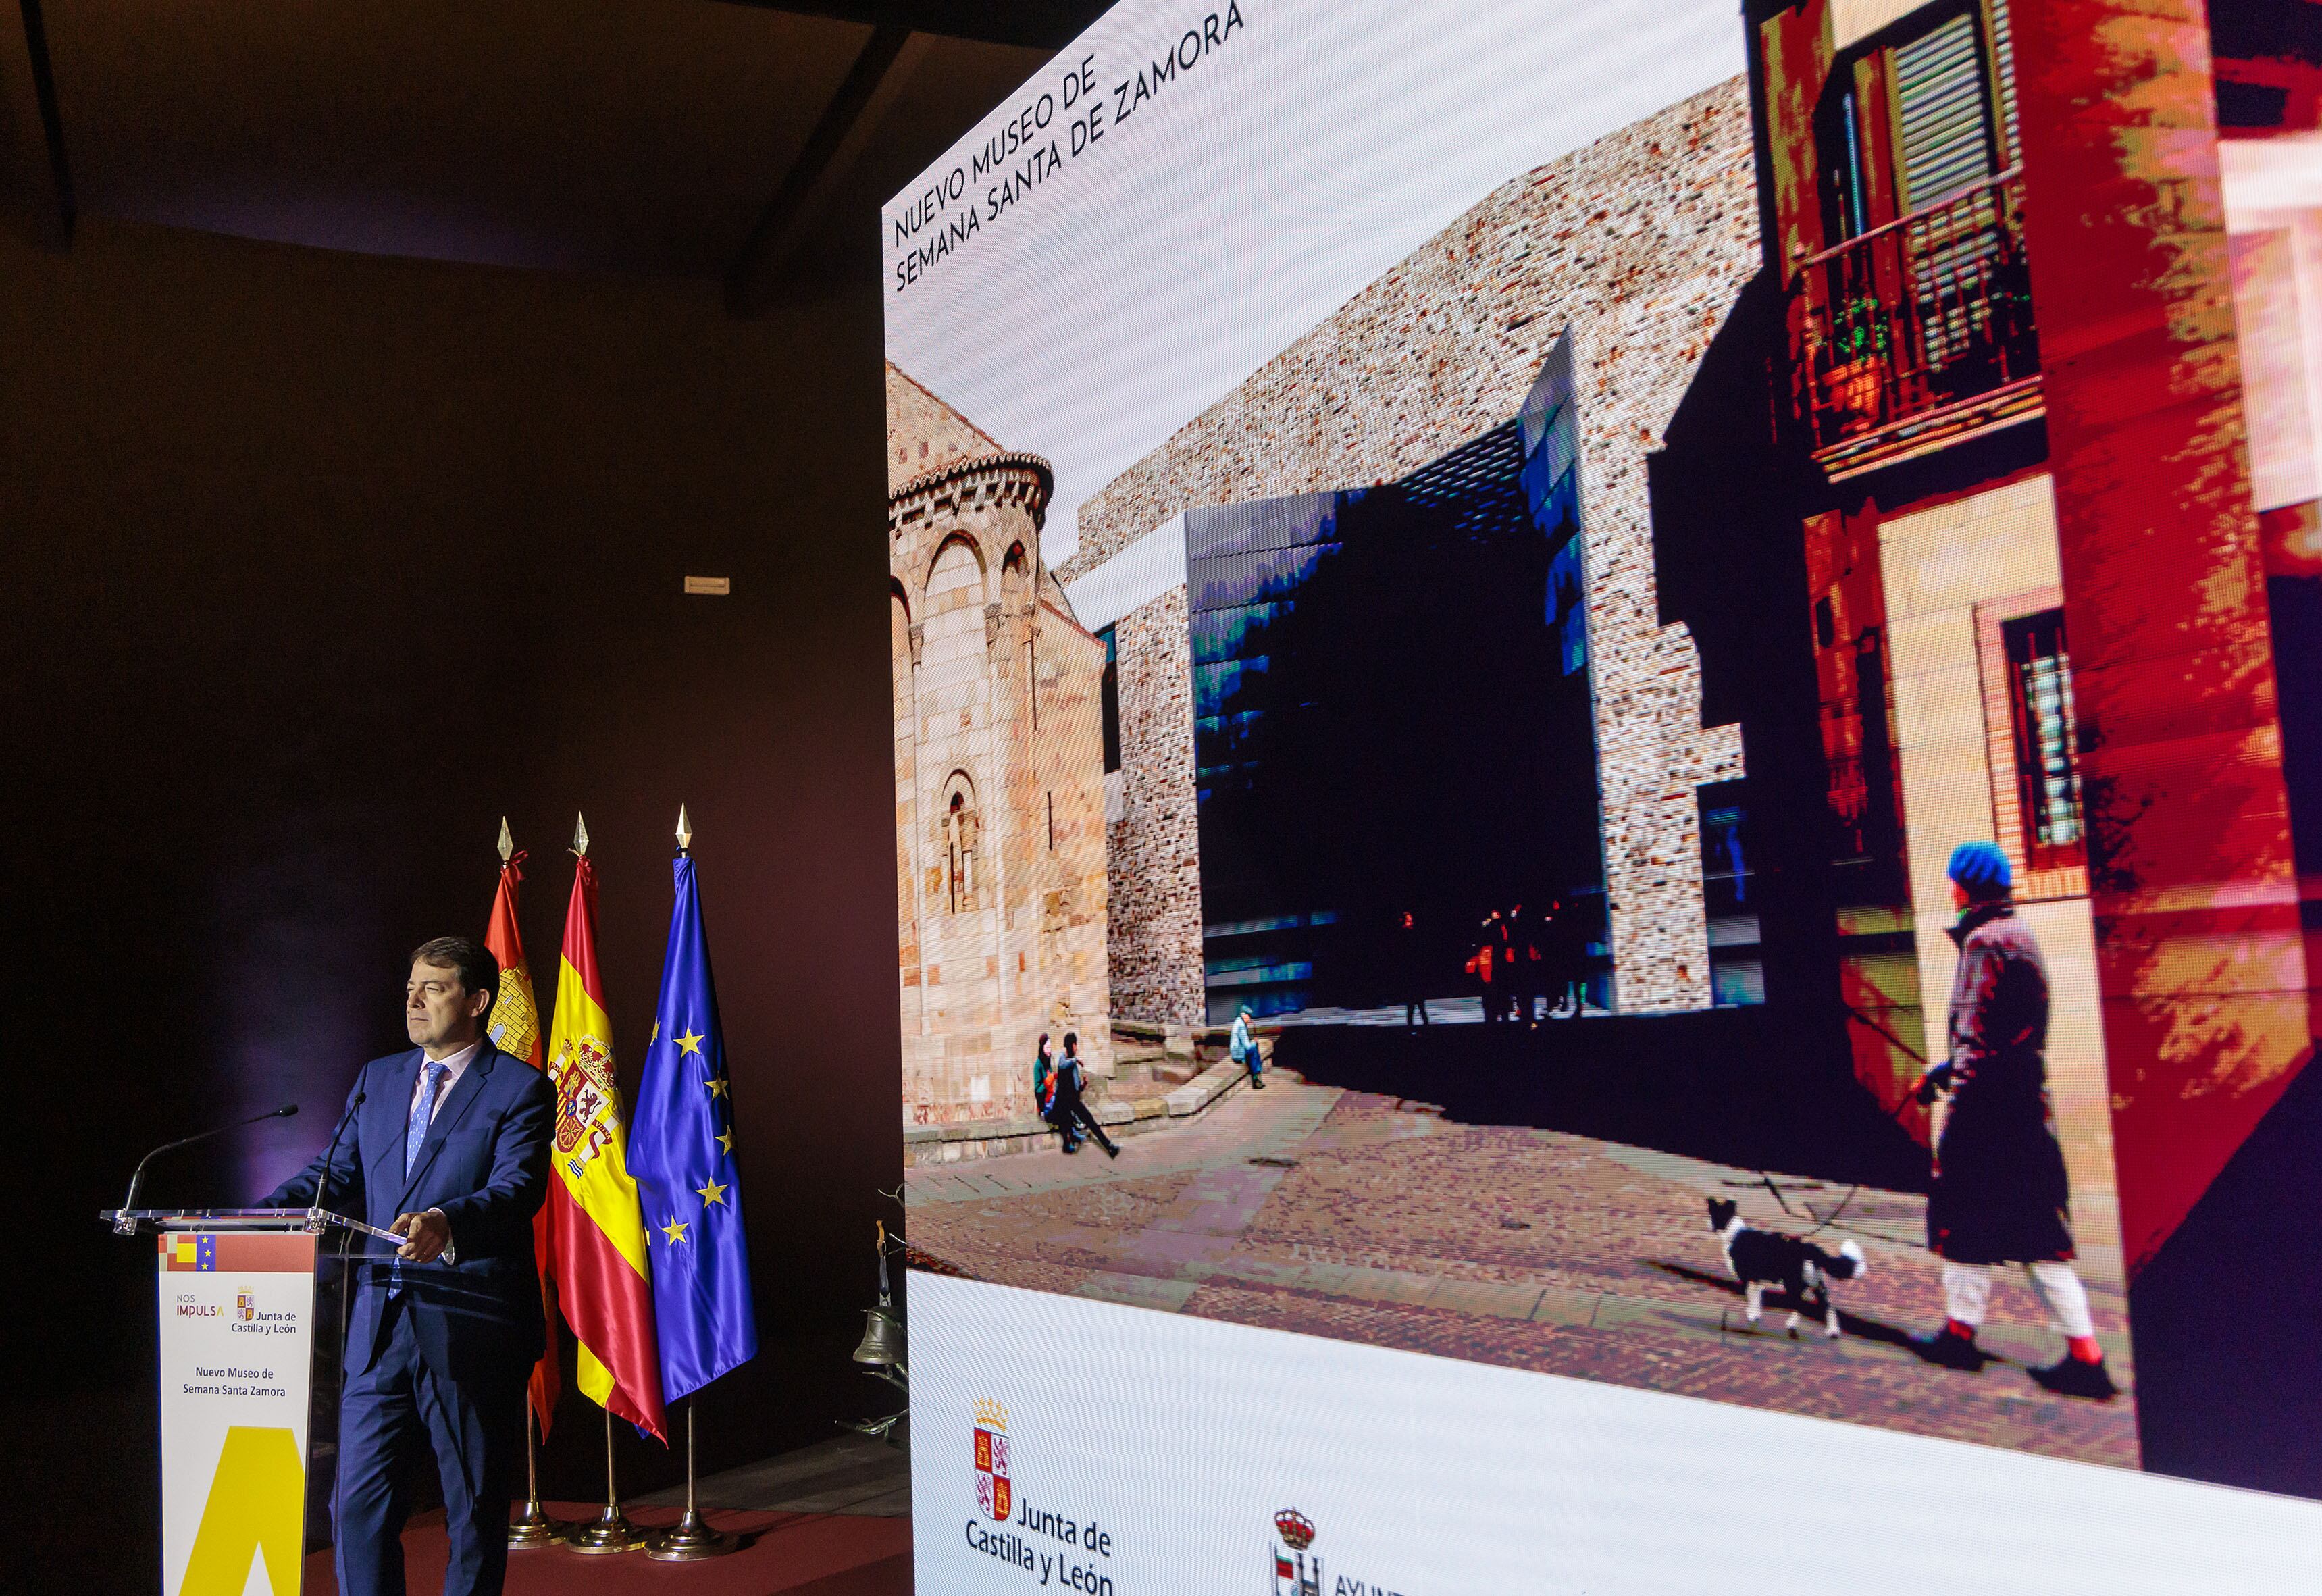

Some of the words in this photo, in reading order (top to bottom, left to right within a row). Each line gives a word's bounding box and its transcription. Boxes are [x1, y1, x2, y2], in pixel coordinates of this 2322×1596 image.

[895, 167, 964, 248] NUEVO
[973, 93, 1054, 184] MUSEO
[1063, 53, 1096, 110] DE
[896, 204, 980, 292] SEMANA
[987, 140, 1062, 222] SANTA
[1071, 102, 1104, 158] DE
[1113, 0, 1244, 126] ZAMORA
[176, 1294, 195, 1303] NOS
[256, 1312, 282, 1322] Junta
[284, 1312, 296, 1322] de
[231, 1322, 263, 1333] Castilla
[265, 1325, 272, 1335] y
[274, 1324, 296, 1334] León
[195, 1366, 226, 1378] Nuevo
[228, 1368, 259, 1379] Museo
[261, 1368, 274, 1379] de
[183, 1383, 220, 1395] Semana
[222, 1385, 248, 1395] Santa
[250, 1385, 286, 1397] Zamora
[1017, 1497, 1077, 1545] Junta
[1083, 1520, 1111, 1558] de
[966, 1519, 1034, 1572] Castilla
[1039, 1553, 1052, 1586] y
[1060, 1553, 1113, 1596] León
